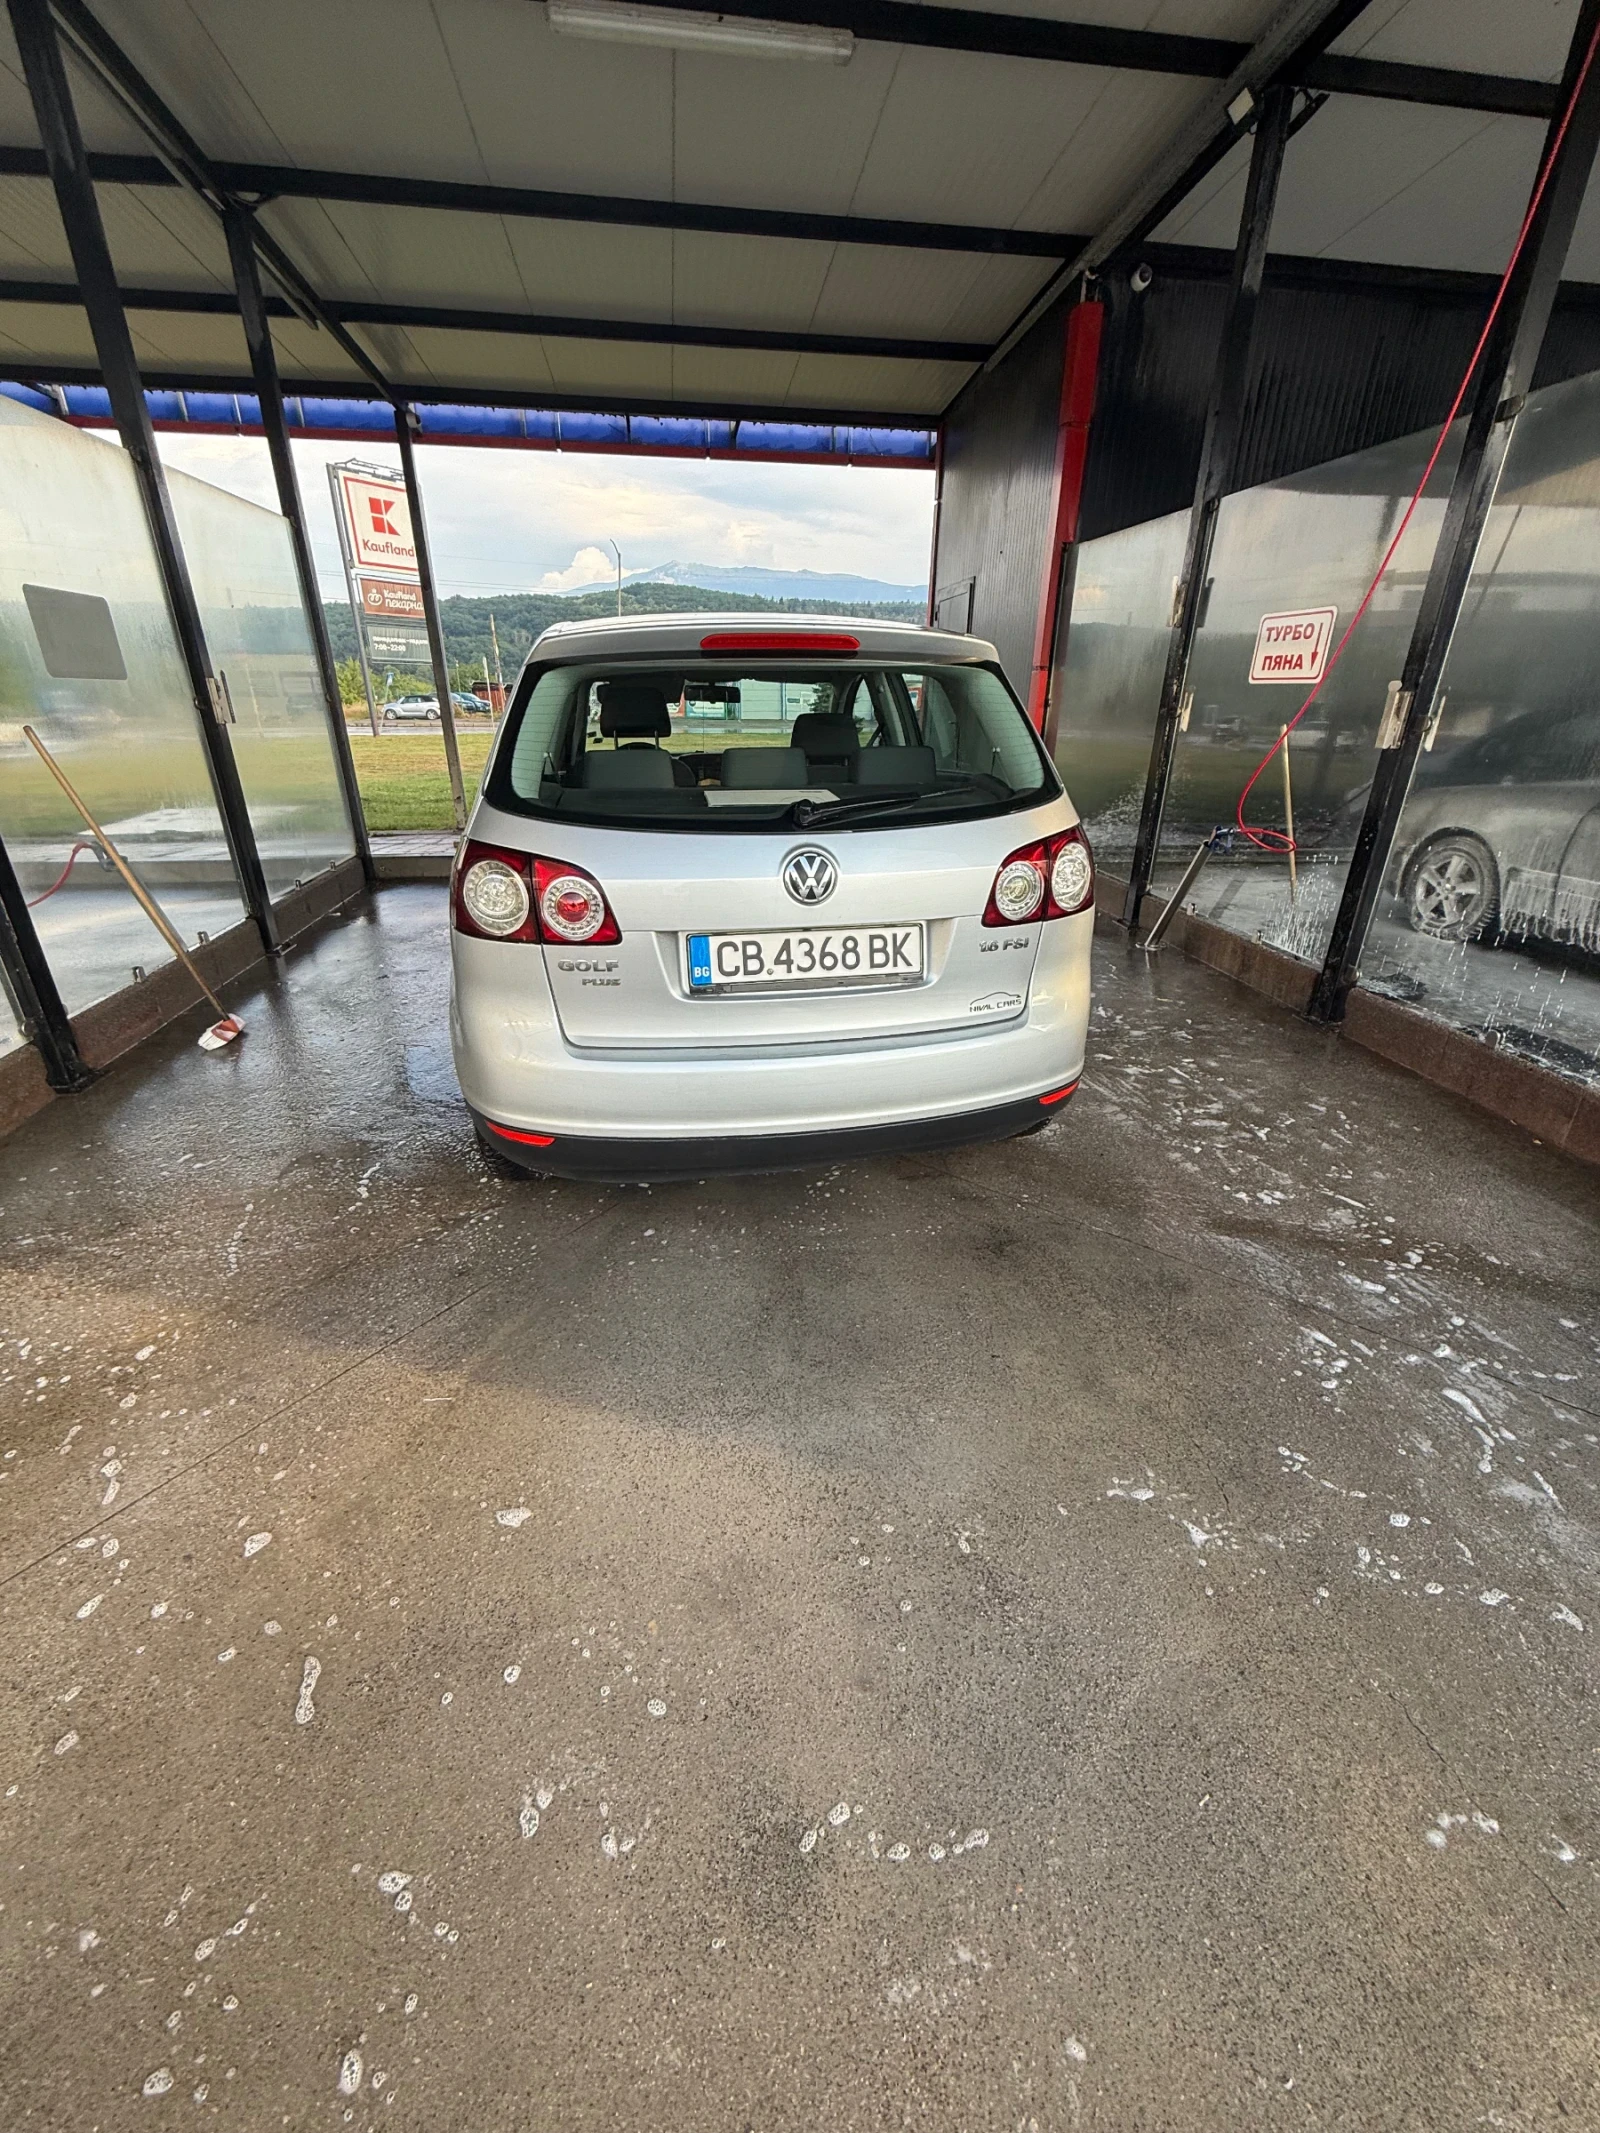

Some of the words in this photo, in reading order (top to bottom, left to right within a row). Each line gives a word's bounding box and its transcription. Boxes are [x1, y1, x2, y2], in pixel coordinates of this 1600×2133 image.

[363, 538, 415, 557] Kaufland
[1266, 623, 1315, 642] ТУРБО
[1262, 654, 1303, 670] ПЯНА
[1003, 938, 1029, 951] FSI
[774, 936, 860, 973] 4368
[558, 960, 619, 972] GOLF
[694, 966, 710, 978] BG
[582, 978, 621, 986] PLUS
